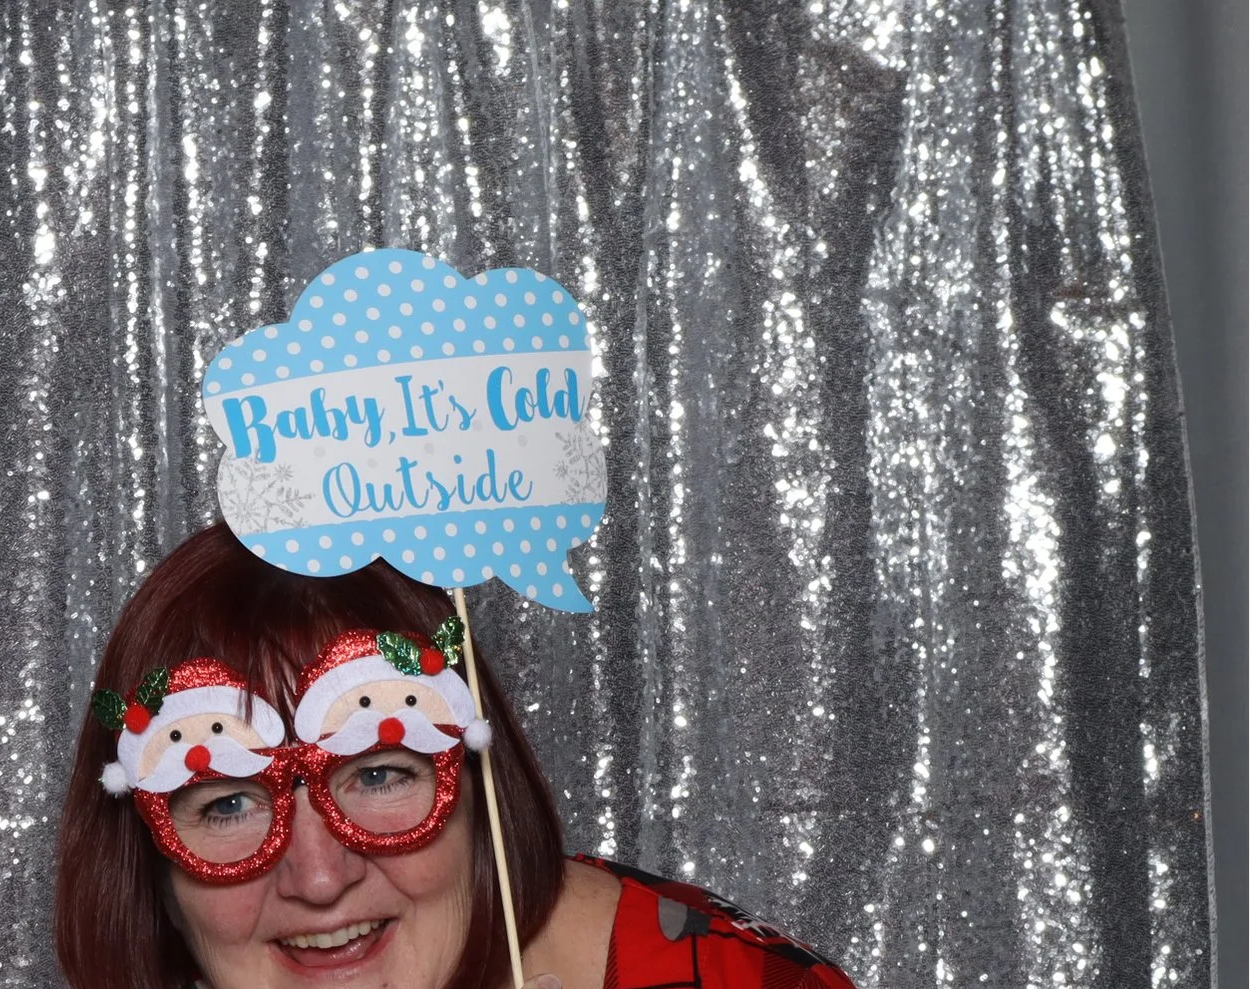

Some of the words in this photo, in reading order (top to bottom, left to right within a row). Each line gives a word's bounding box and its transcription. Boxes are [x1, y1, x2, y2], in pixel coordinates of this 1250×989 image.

[395, 375, 477, 437] It's
[486, 366, 585, 432] Cold
[322, 449, 533, 518] Outside
